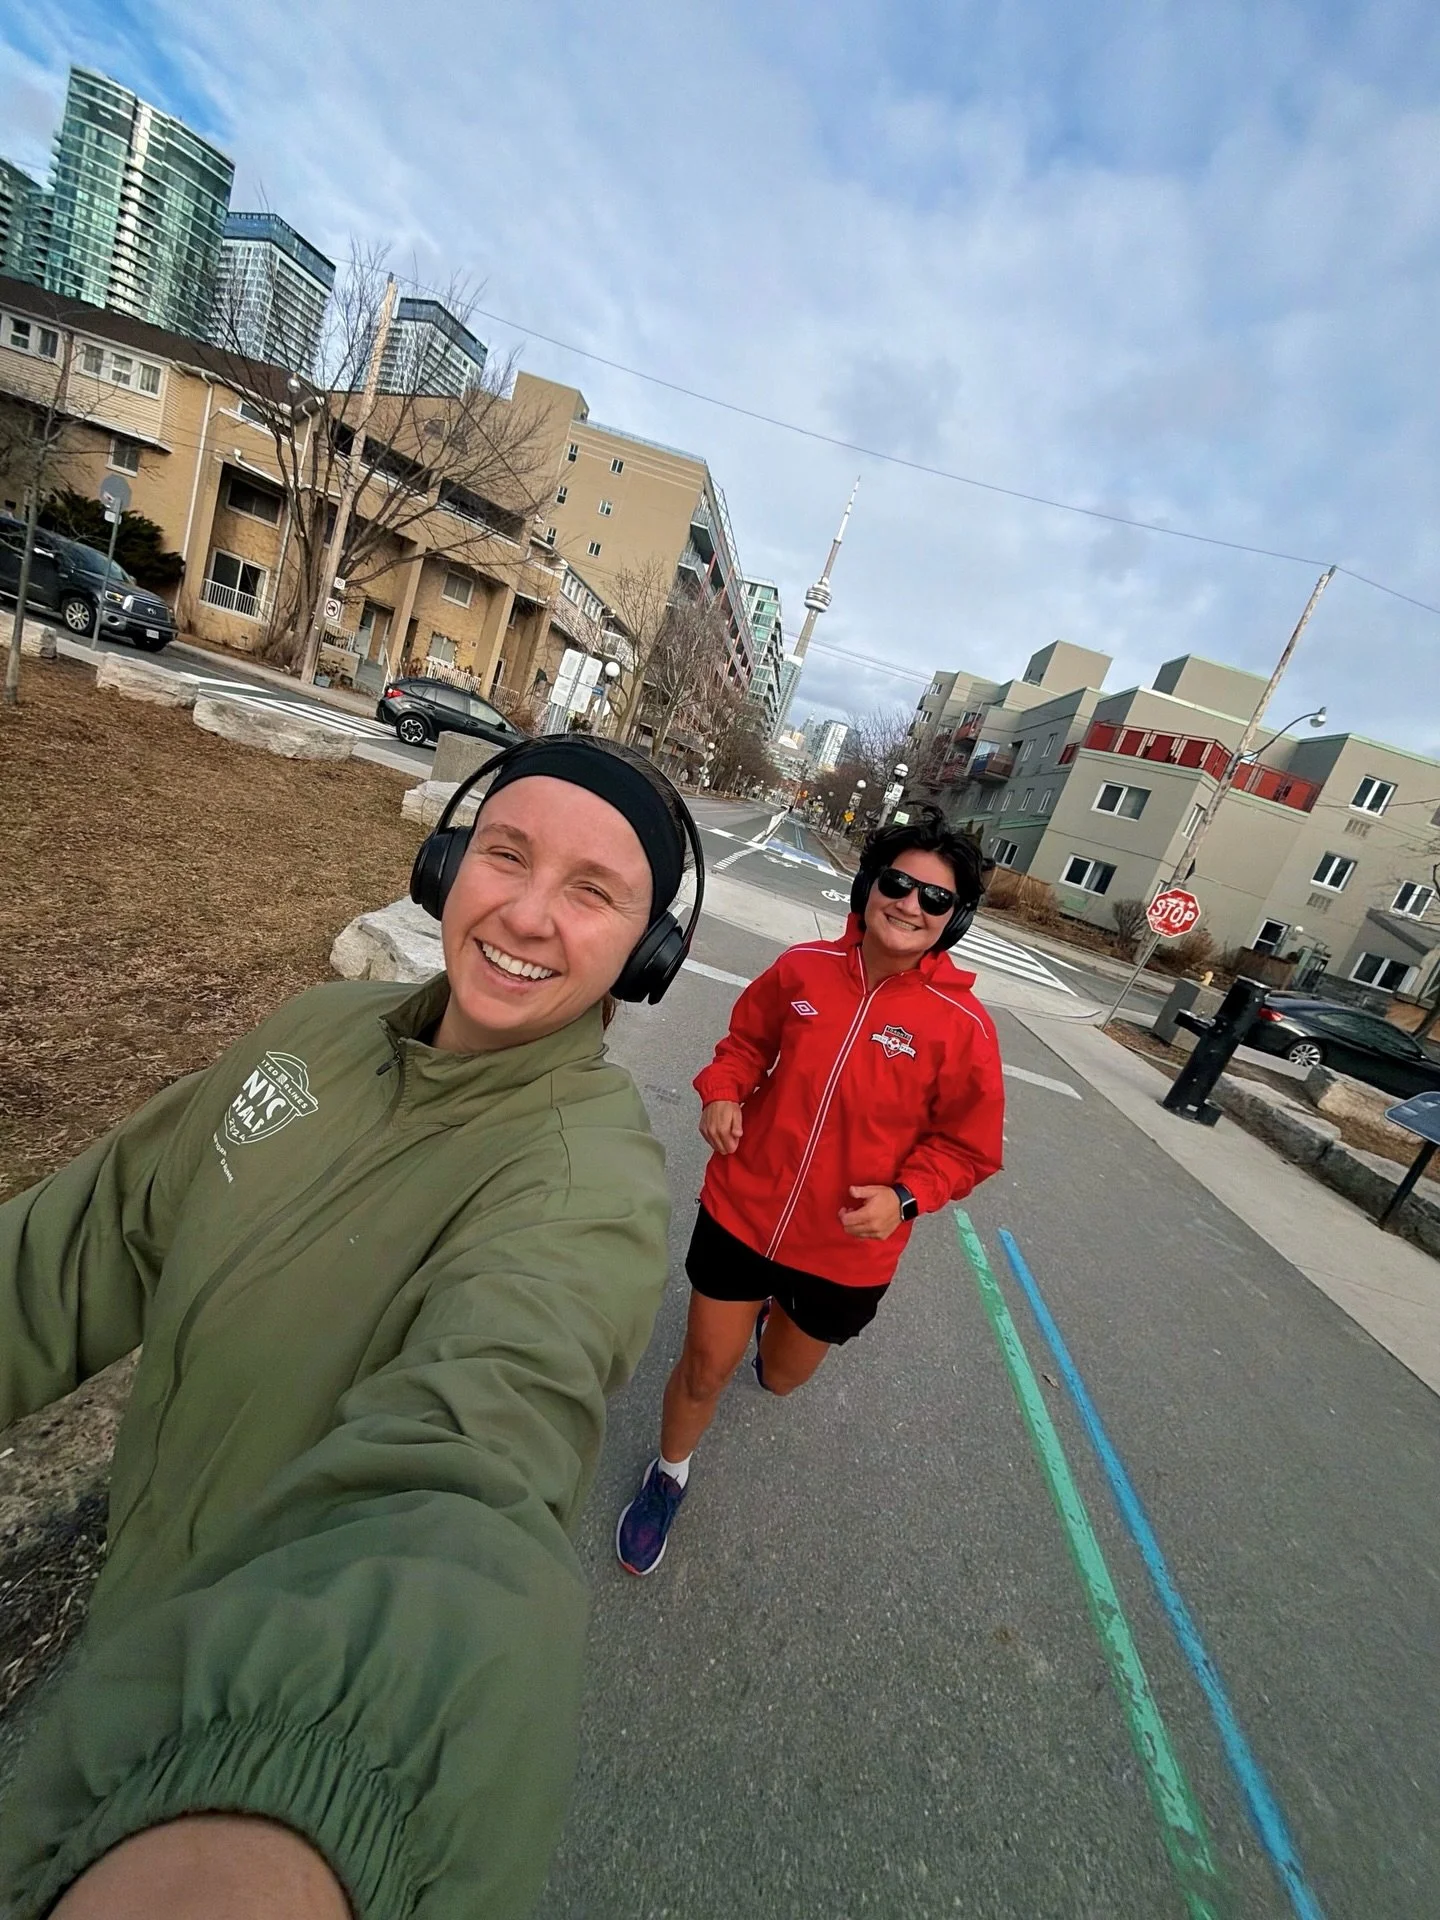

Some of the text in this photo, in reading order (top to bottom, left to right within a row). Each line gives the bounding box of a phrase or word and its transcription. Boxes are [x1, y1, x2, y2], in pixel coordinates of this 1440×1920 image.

[1152, 899, 1195, 928] STOP
[232, 1094, 265, 1133] HALF
[242, 1070, 286, 1120] NYC
